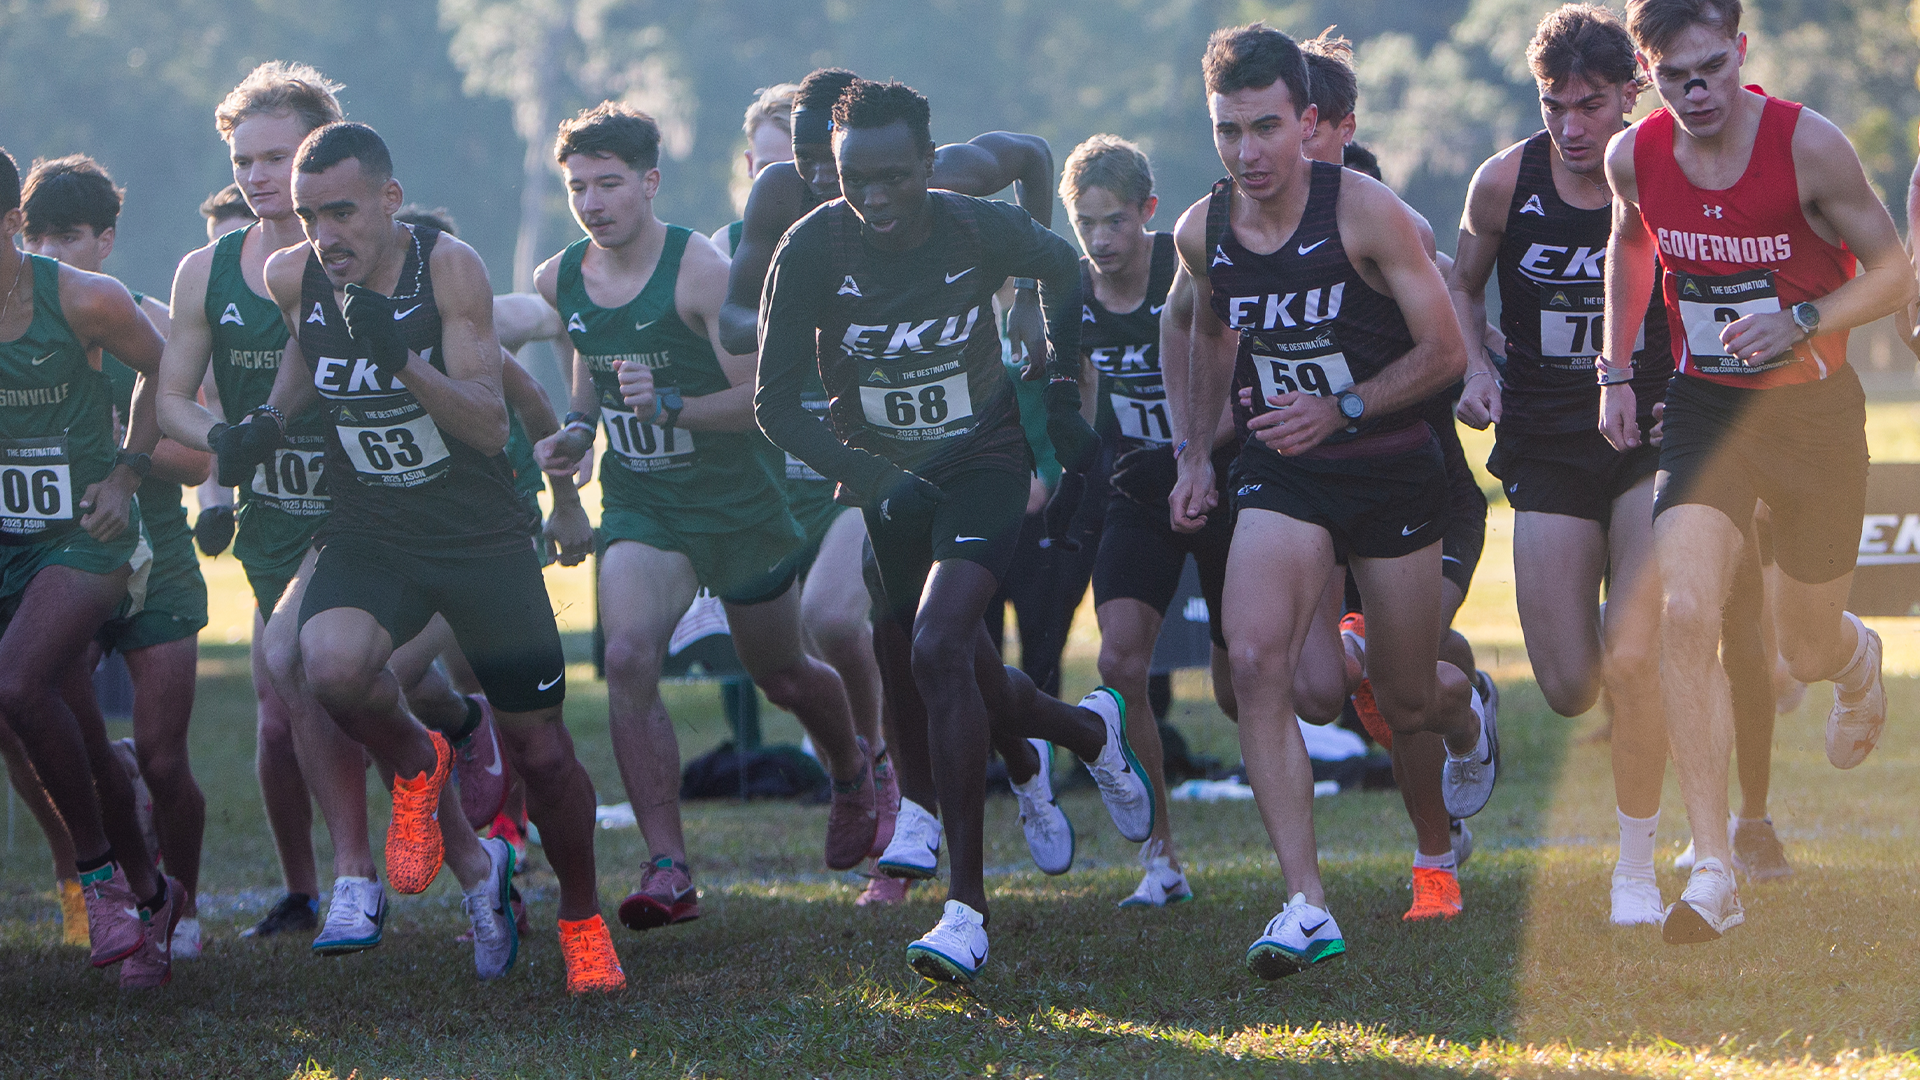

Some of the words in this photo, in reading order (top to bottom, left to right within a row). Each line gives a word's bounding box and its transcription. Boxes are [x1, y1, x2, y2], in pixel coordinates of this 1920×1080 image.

[1657, 227, 1792, 264] GOVERNORS
[1710, 286, 1723, 295] THE
[1723, 279, 1770, 295] DESTINATION.
[1229, 281, 1346, 329] EKU
[1583, 297, 1596, 305] THE
[841, 305, 980, 354] EKU
[1276, 343, 1289, 352] THE
[1289, 338, 1334, 351] DESTINATION.
[1090, 343, 1162, 371] EK
[1571, 357, 1592, 365] 2025
[1718, 357, 1740, 367] 2025
[902, 372, 916, 380] THE
[916, 360, 961, 378] DESTINATION.
[1270, 360, 1334, 397] 59
[884, 384, 949, 426] 68
[364, 411, 377, 419] THE
[1130, 402, 1172, 439] 71
[896, 429, 919, 437] 2025
[921, 426, 945, 436] ASUN
[284, 435, 296, 444] THE
[6, 449, 19, 457] THE
[358, 427, 424, 471] 63
[381, 475, 402, 483] 2025
[402, 470, 427, 482] ASUN
[302, 500, 326, 510] ASUN
[1, 517, 22, 528] 2025
[23, 519, 46, 529] ASUN
